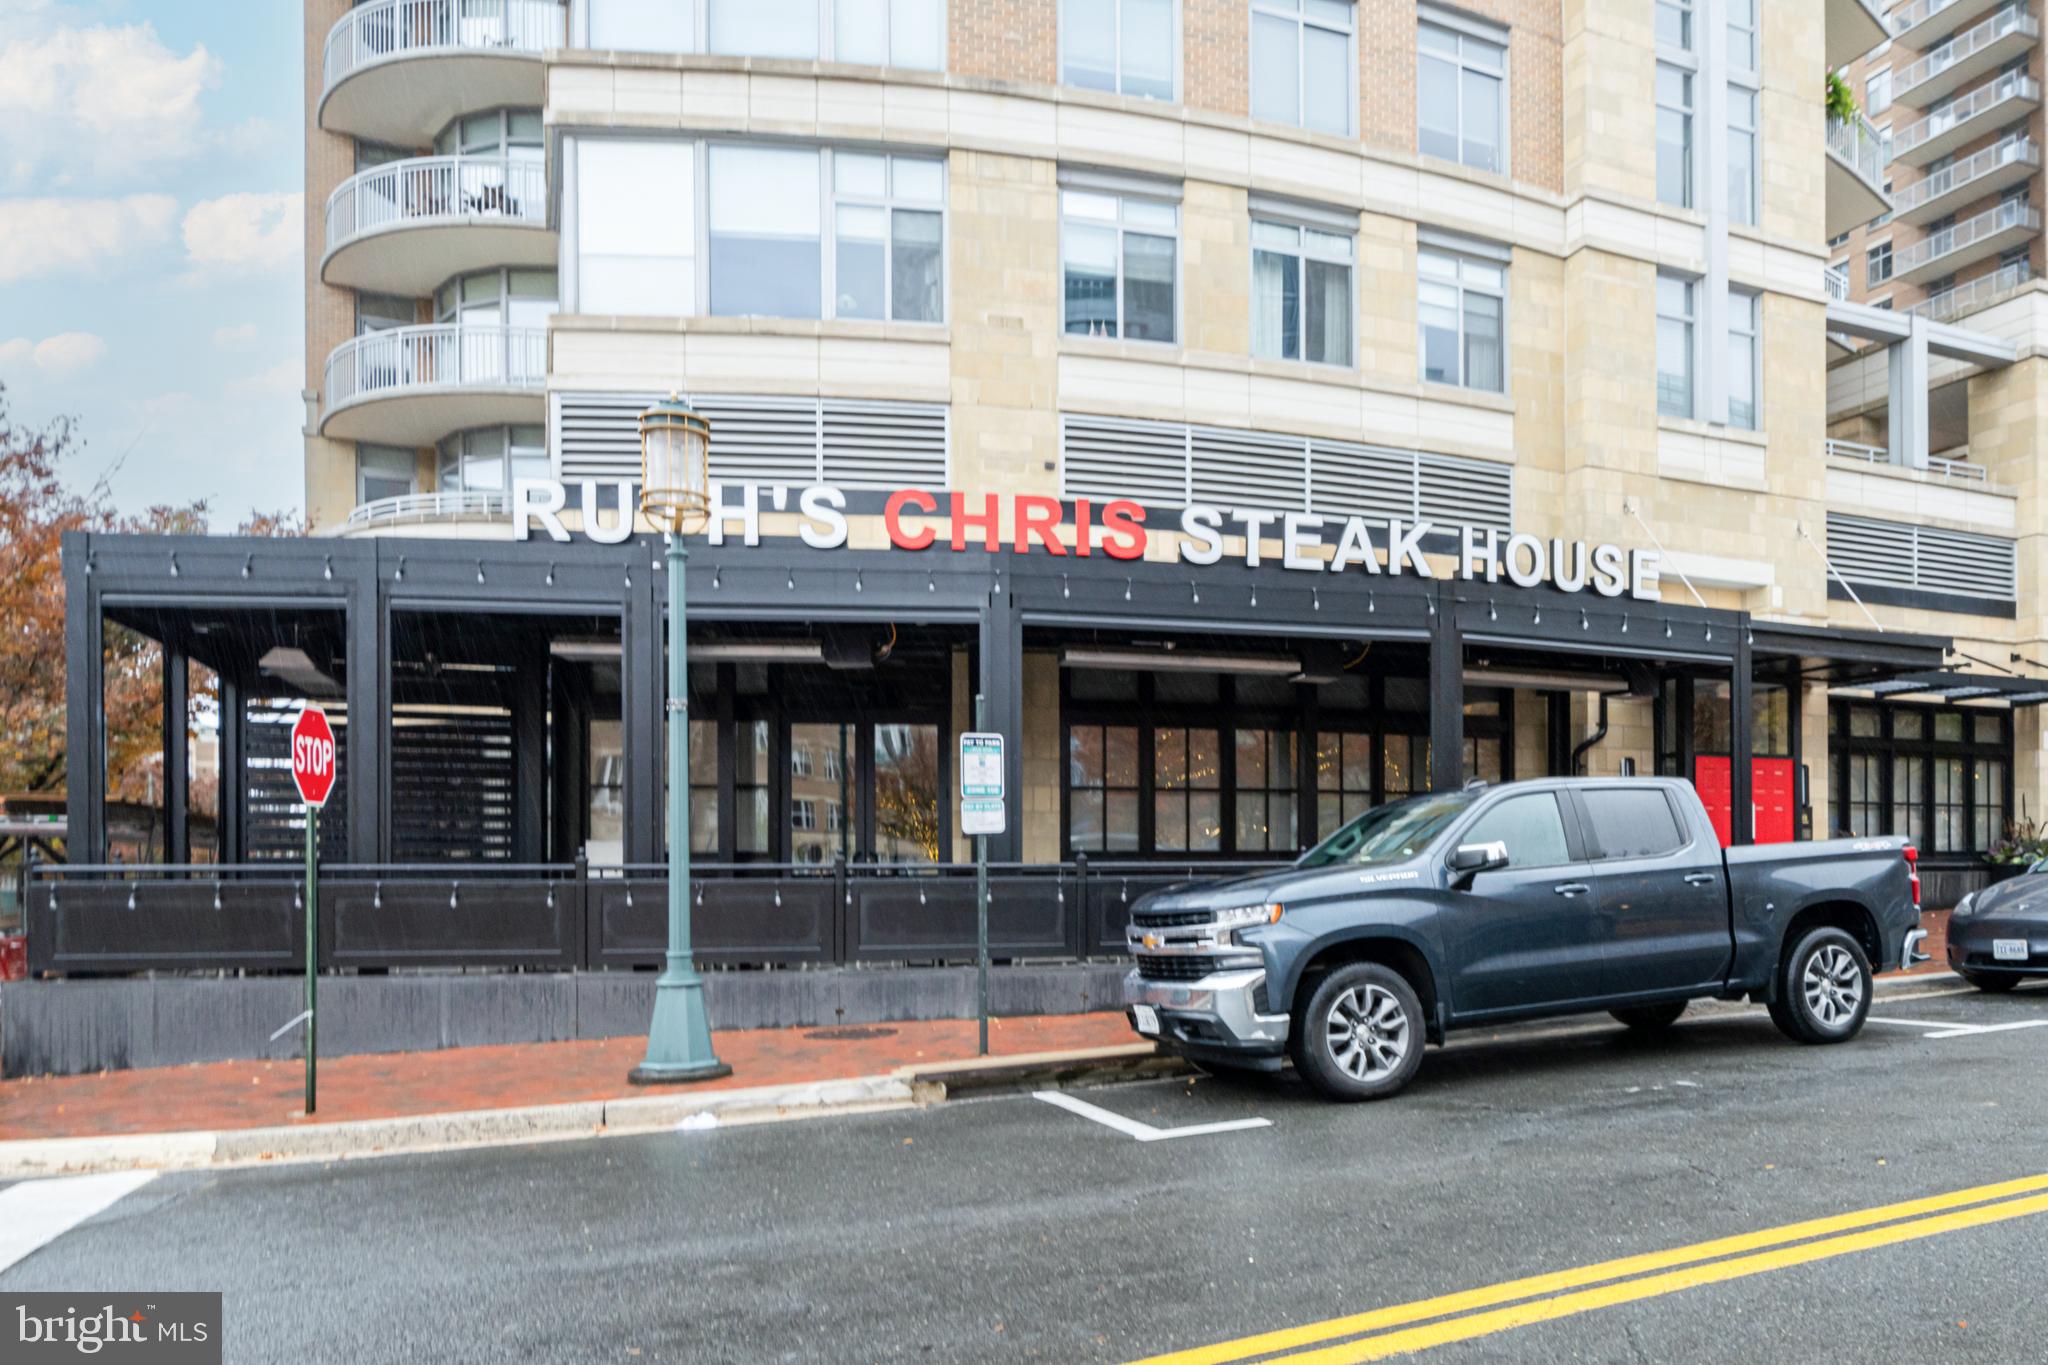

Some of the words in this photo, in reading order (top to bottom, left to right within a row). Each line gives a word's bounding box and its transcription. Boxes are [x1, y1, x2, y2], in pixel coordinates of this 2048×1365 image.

[513, 478, 849, 550] RUH'S
[884, 488, 1148, 561] CHRIS
[1179, 504, 1433, 580] STEAK
[1460, 524, 1663, 602] HOUSE
[295, 733, 333, 777] STOP
